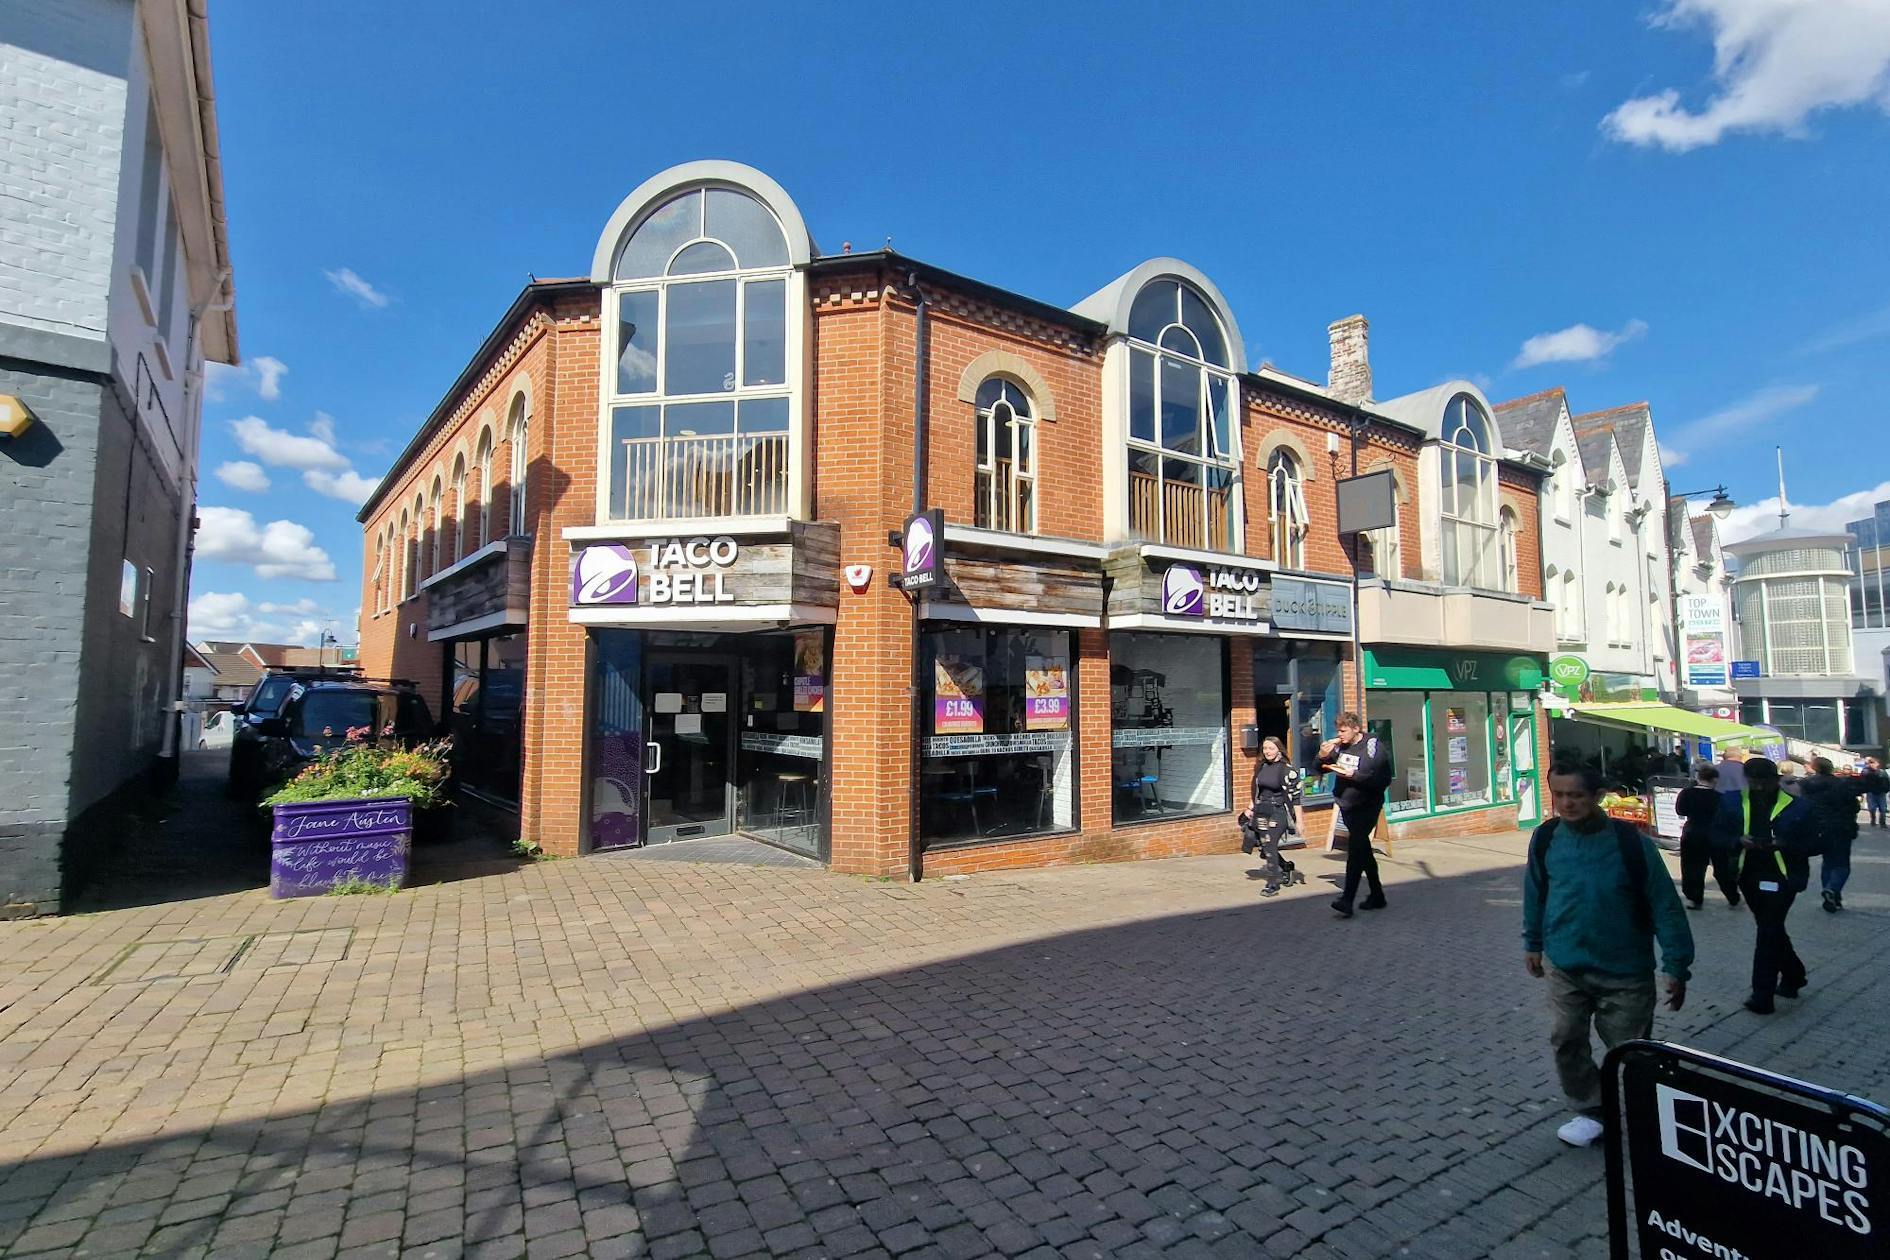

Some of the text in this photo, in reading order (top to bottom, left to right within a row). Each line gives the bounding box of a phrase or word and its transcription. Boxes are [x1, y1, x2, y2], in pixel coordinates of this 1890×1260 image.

[645, 536, 738, 566] TACO
[904, 571, 934, 587] TACO BELL
[1206, 563, 1259, 591] TACO
[650, 573, 735, 602] BELL
[1209, 593, 1258, 619] BELL
[1276, 600, 1304, 614] DUCK
[1688, 598, 1707, 608] TOP
[1688, 609, 1720, 619] TOWN
[1455, 660, 1478, 680] VPZ
[1556, 663, 1580, 677] VPZ
[946, 700, 973, 717] £1.99
[1034, 698, 1060, 714] £3.99
[288, 810, 405, 838] Jane Austen
